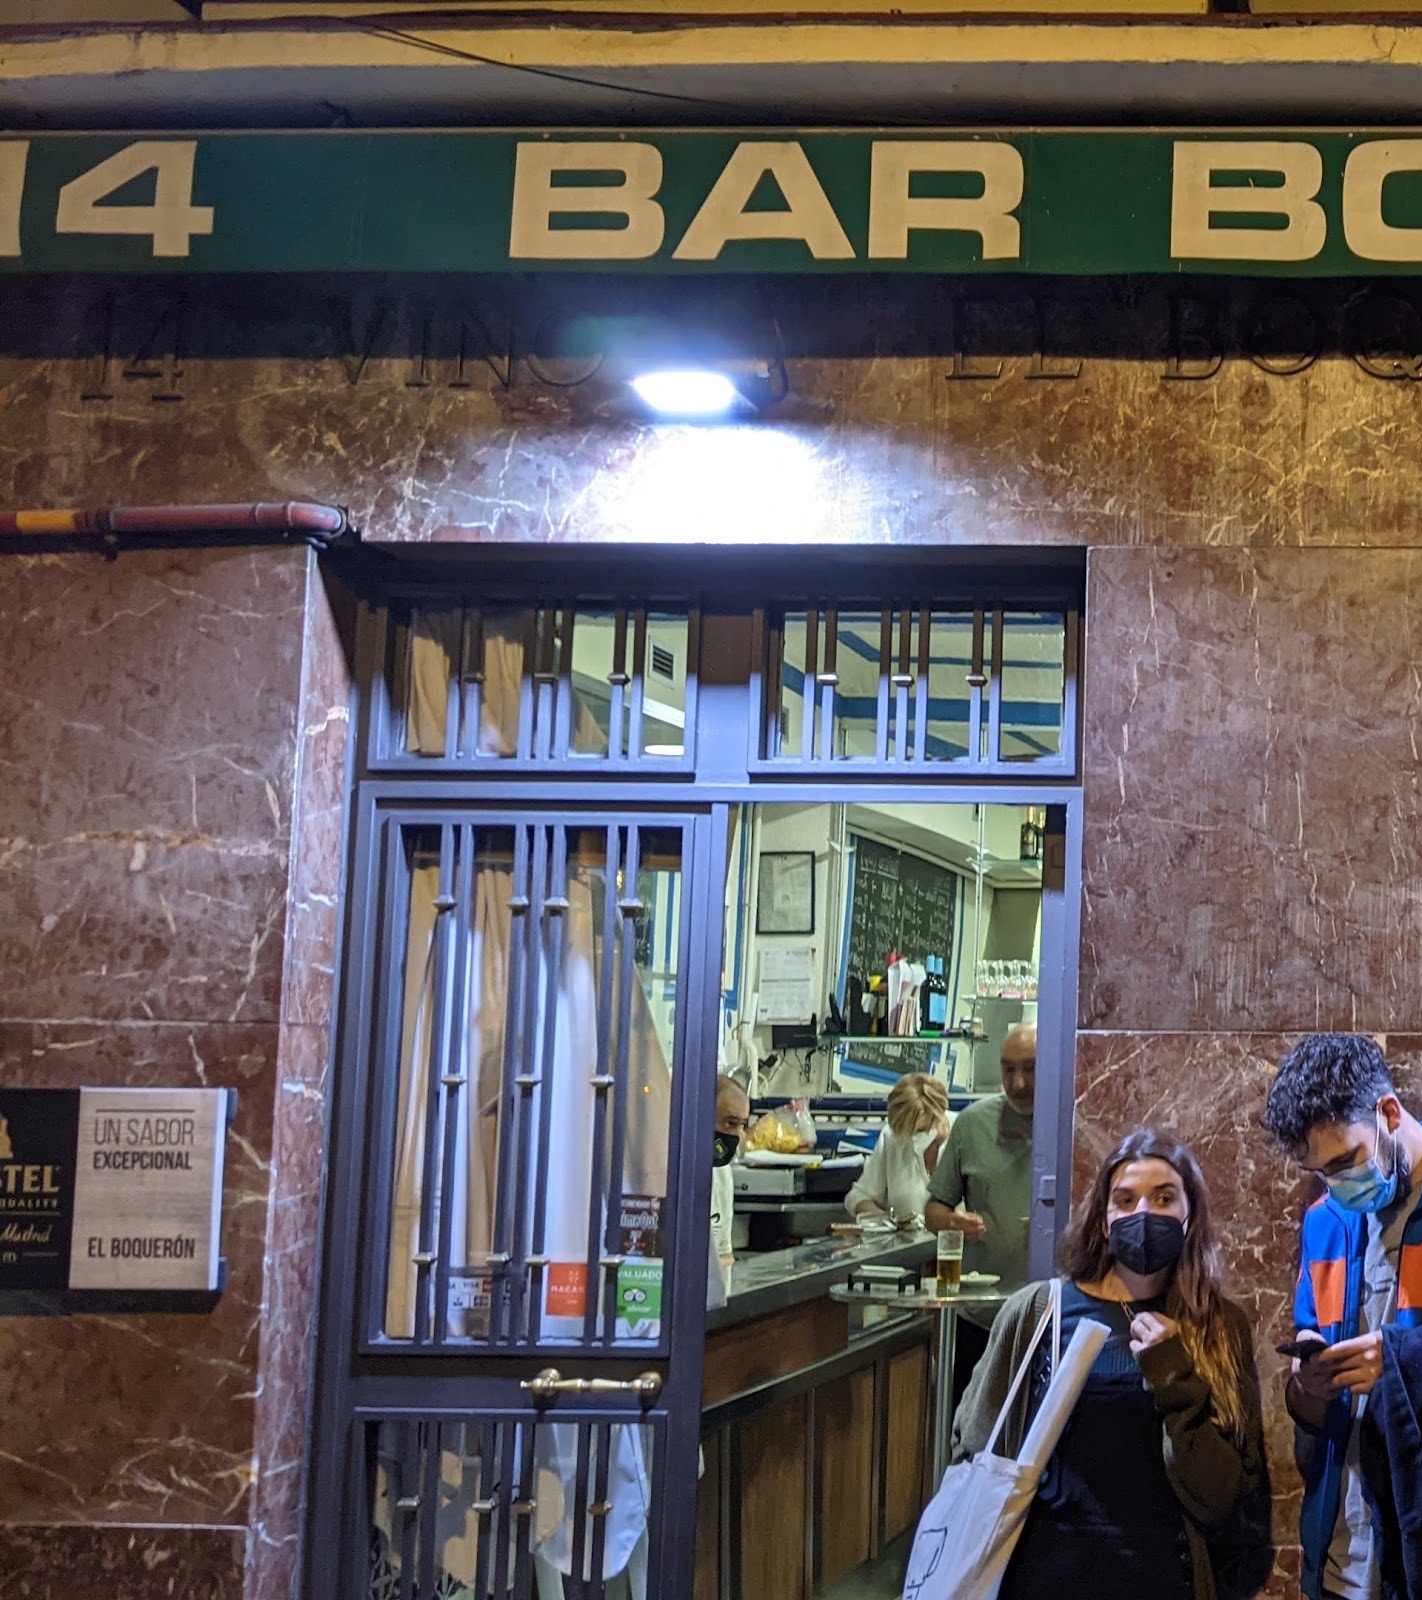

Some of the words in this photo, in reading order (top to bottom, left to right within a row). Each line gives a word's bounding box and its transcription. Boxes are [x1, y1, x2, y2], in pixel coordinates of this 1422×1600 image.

[509, 140, 1025, 261] BAR
[94, 1118, 121, 1146] UN
[127, 1118, 195, 1147] SABOR
[93, 1151, 193, 1171] EXCEPCIONAL
[0, 1165, 60, 1192] TEL
[87, 1236, 106, 1258] EL
[110, 1233, 196, 1259] BOQUERÓN
